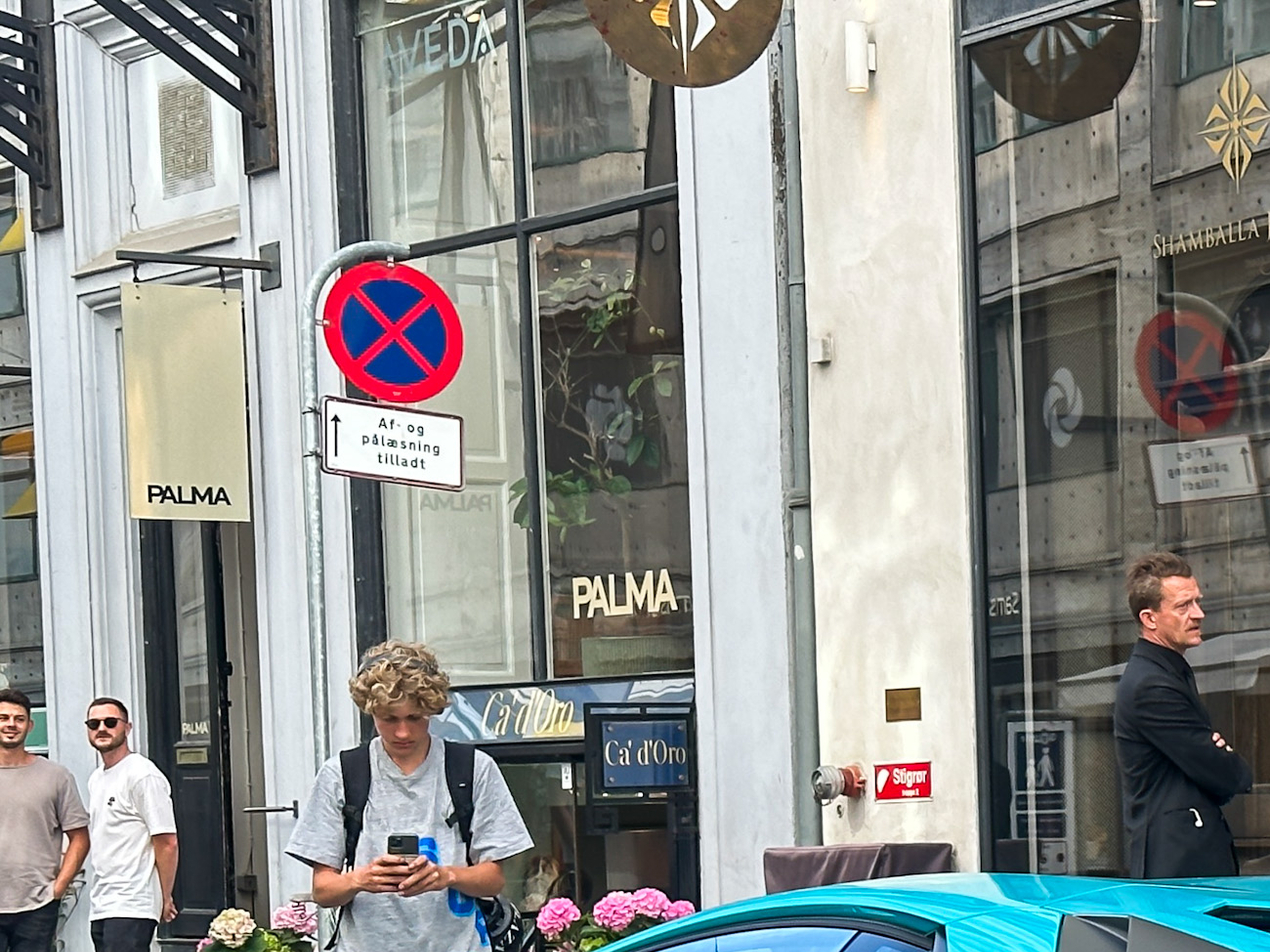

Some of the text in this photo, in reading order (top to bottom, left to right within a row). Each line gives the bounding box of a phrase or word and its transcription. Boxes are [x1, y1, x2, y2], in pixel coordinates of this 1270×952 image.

[1153, 218, 1259, 259] SHAMBALLA
[407, 423, 425, 436] og
[361, 434, 440, 456] pålæsning
[377, 452, 426, 470] tilladt
[147, 484, 232, 506] PALMA
[572, 568, 679, 619] PALMA
[182, 722, 209, 735] PALMA
